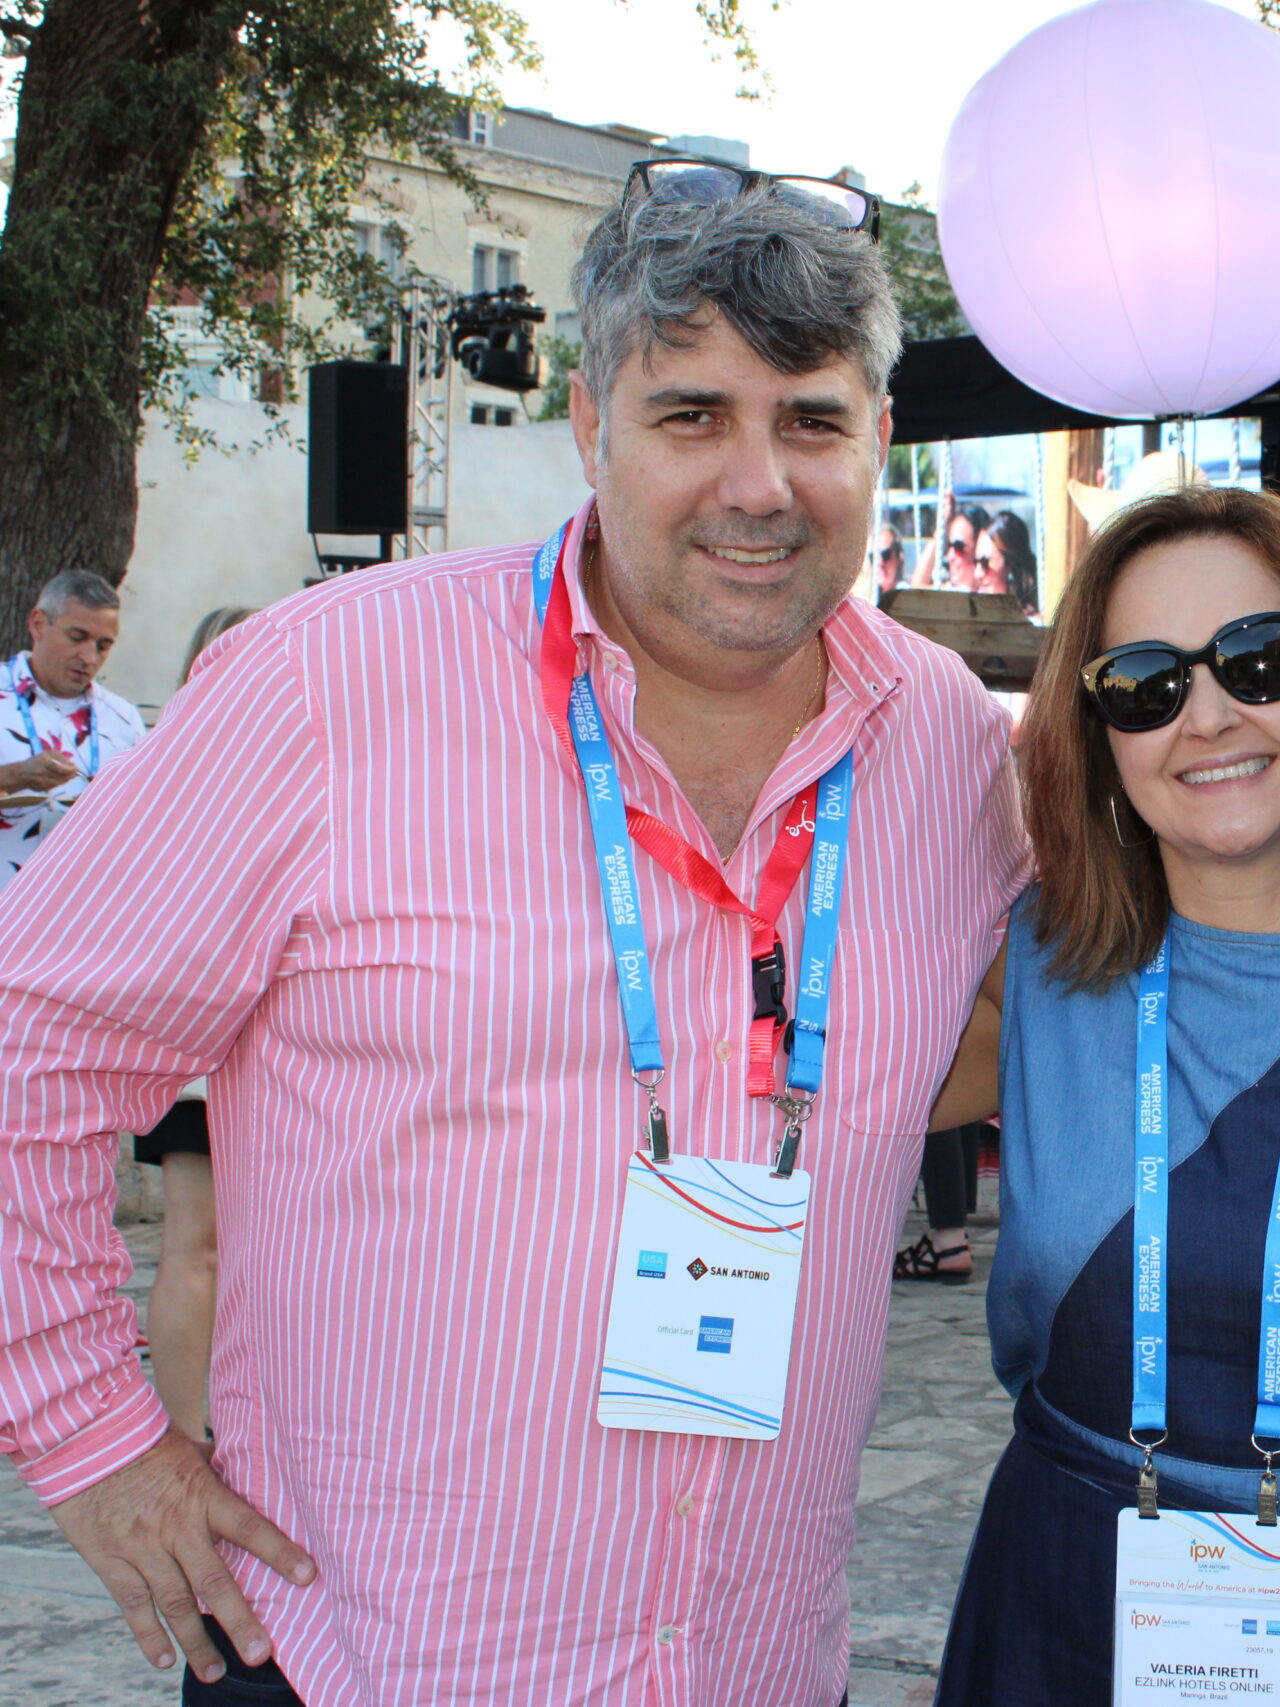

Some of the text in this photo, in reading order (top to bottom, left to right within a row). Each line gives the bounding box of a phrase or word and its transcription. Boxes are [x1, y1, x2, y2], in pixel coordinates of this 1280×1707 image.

[586, 763, 613, 801] ipw
[819, 784, 845, 820] ipw
[604, 855, 626, 926] EXPRESS
[613, 844, 637, 925] AMERICAN
[812, 841, 829, 917] AMERICAN
[823, 844, 840, 910] EXPRESS
[619, 950, 645, 992] ipw
[801, 957, 826, 998] ipw
[1140, 991, 1165, 1024] ipw
[1141, 1072, 1151, 1135] EXPRESS
[1151, 1063, 1162, 1135] AMERICAN
[1138, 1156, 1164, 1193] ipw
[710, 1266, 770, 1281] SAN ANTONIO
[1139, 1244, 1149, 1312] EXPRESS
[1150, 1235, 1161, 1313] AMERICAN
[657, 1326, 694, 1335] Official Card
[1136, 1336, 1163, 1375] ipw
[1264, 1327, 1278, 1402] AMERICAN
[1190, 1539, 1226, 1562] ipw
[1129, 1579, 1161, 1589] Bringing
[1215, 1585, 1246, 1593] America
[1131, 1609, 1161, 1630] ipw
[1134, 1676, 1275, 1694] EZLINK HOTELS ONLINE
[1150, 1663, 1259, 1679] VALERIA FIRETTI
[1210, 1692, 1228, 1700] Brazil
